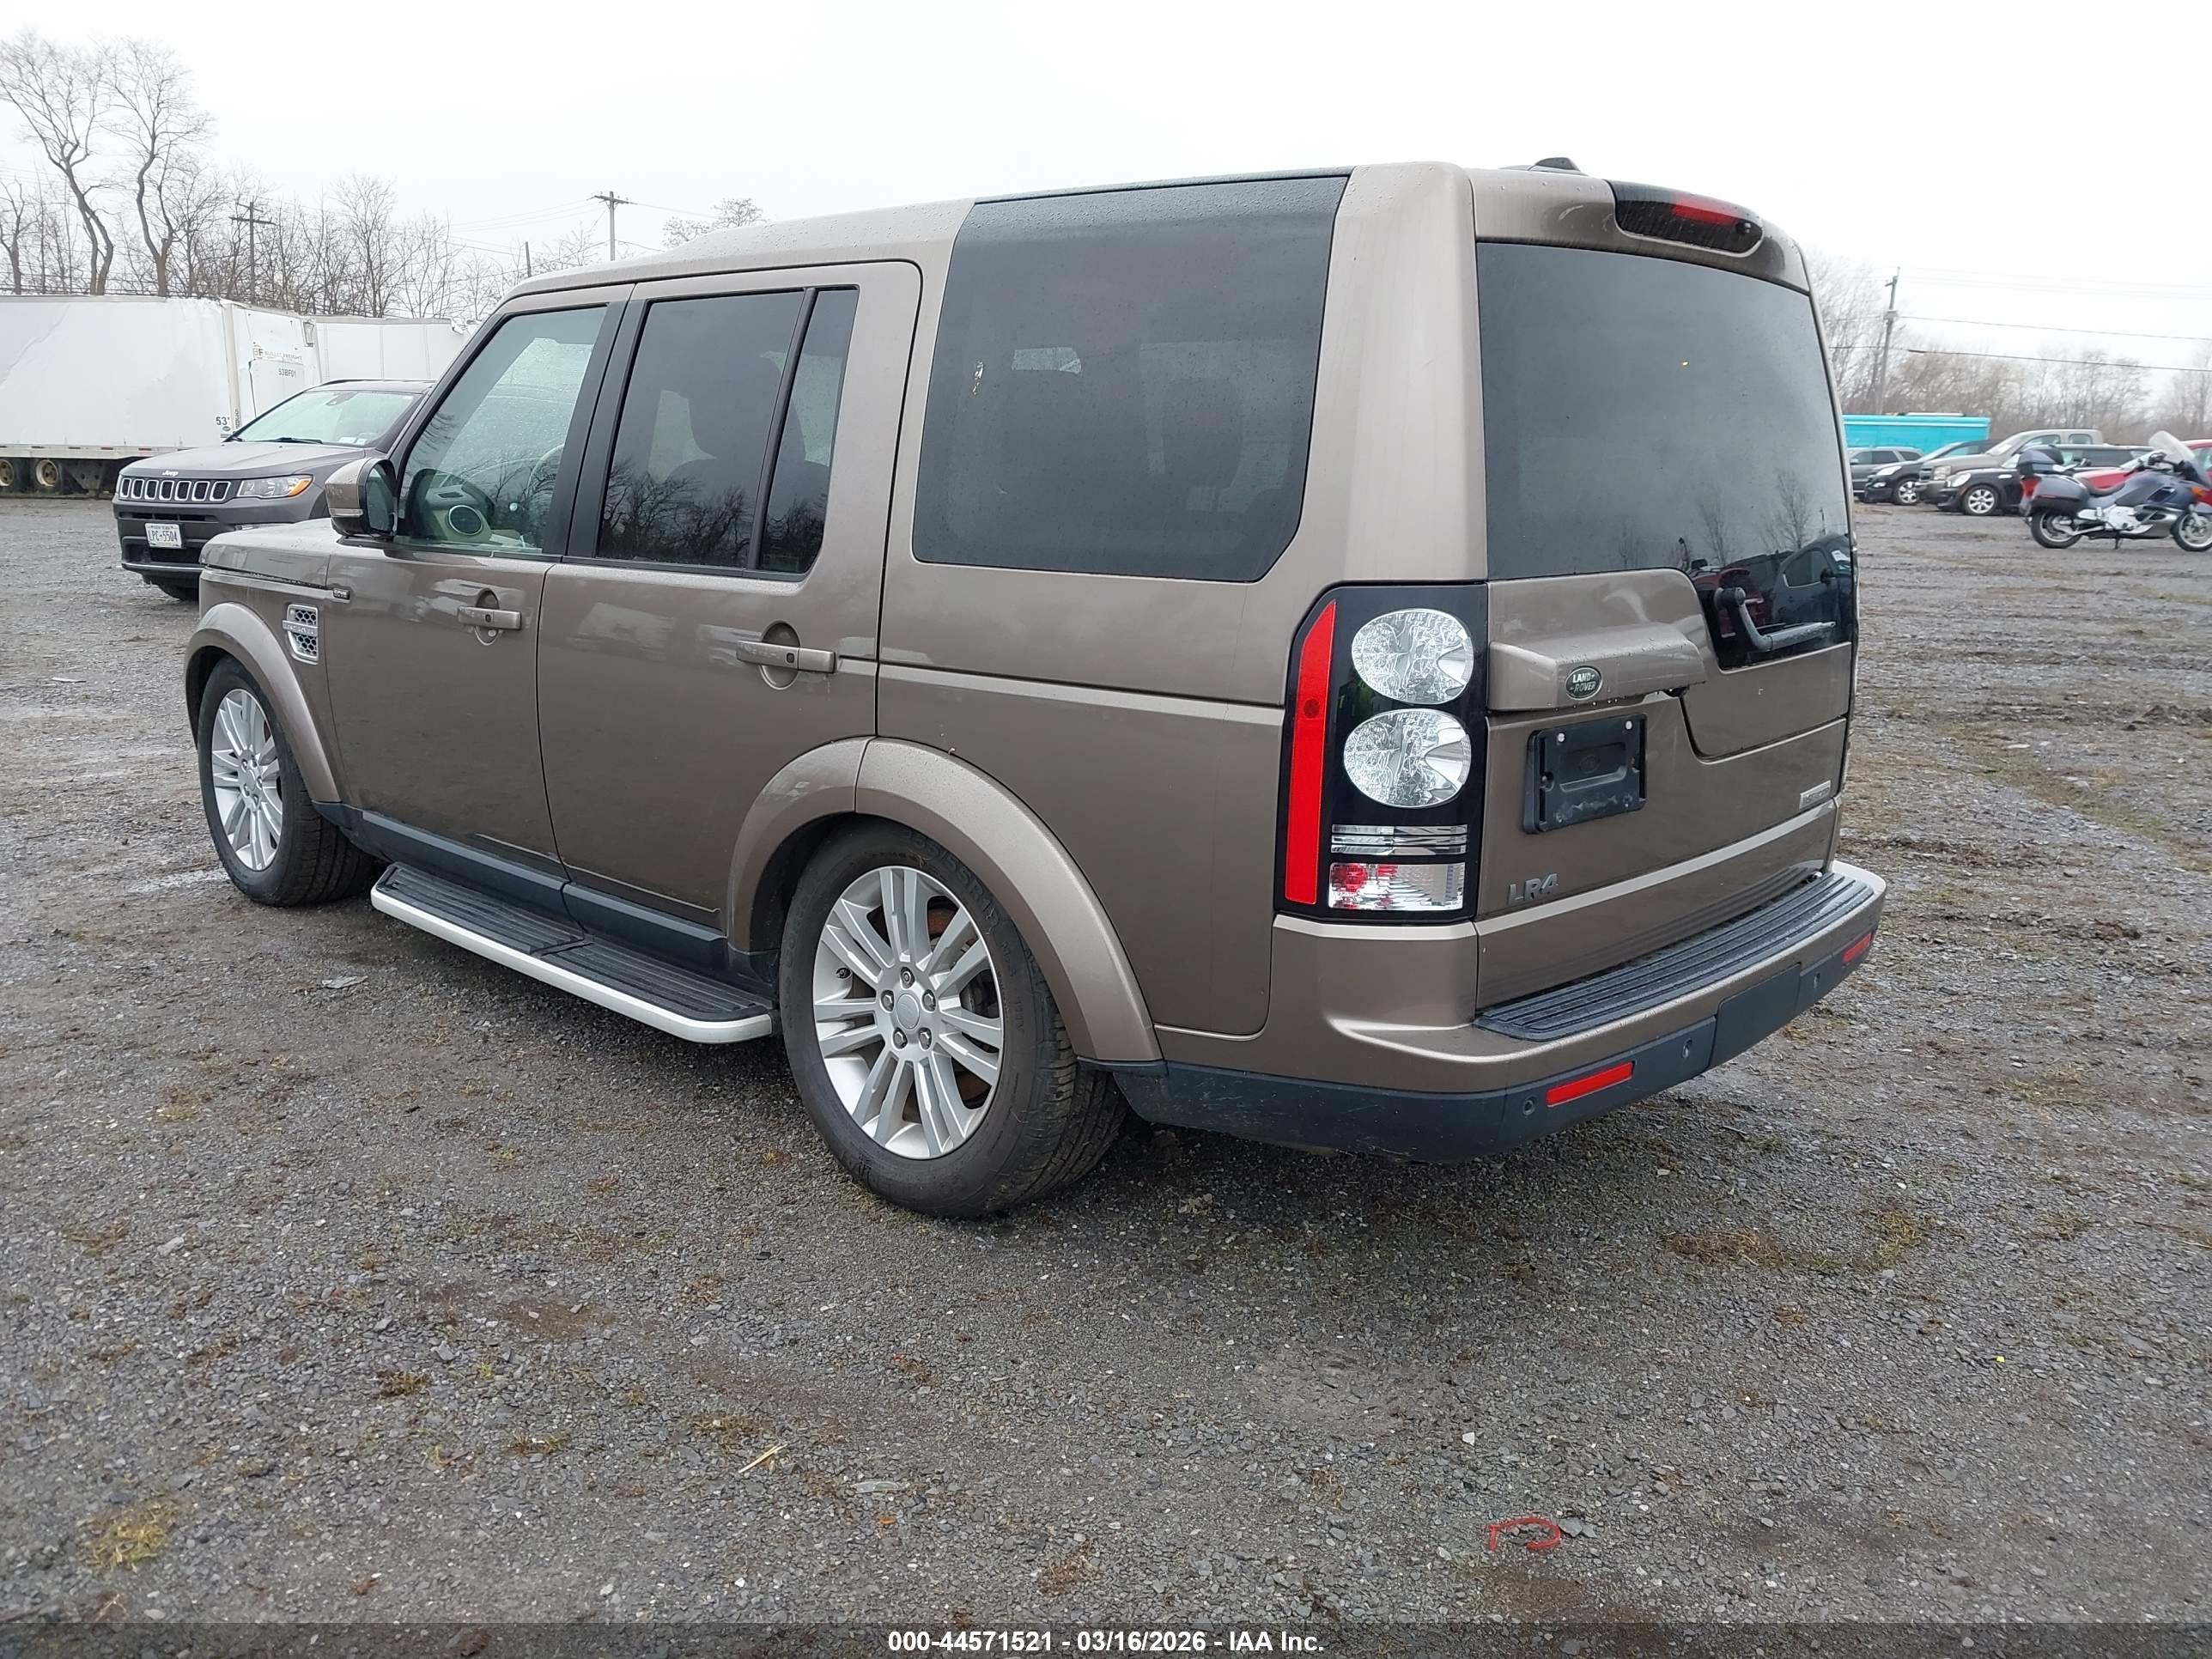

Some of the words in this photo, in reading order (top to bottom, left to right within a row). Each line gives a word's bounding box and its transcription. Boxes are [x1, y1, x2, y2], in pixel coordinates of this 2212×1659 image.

[1572, 672, 1591, 684] LAND
[1574, 681, 1596, 693] ROVER
[1506, 872, 1559, 908] LR4
